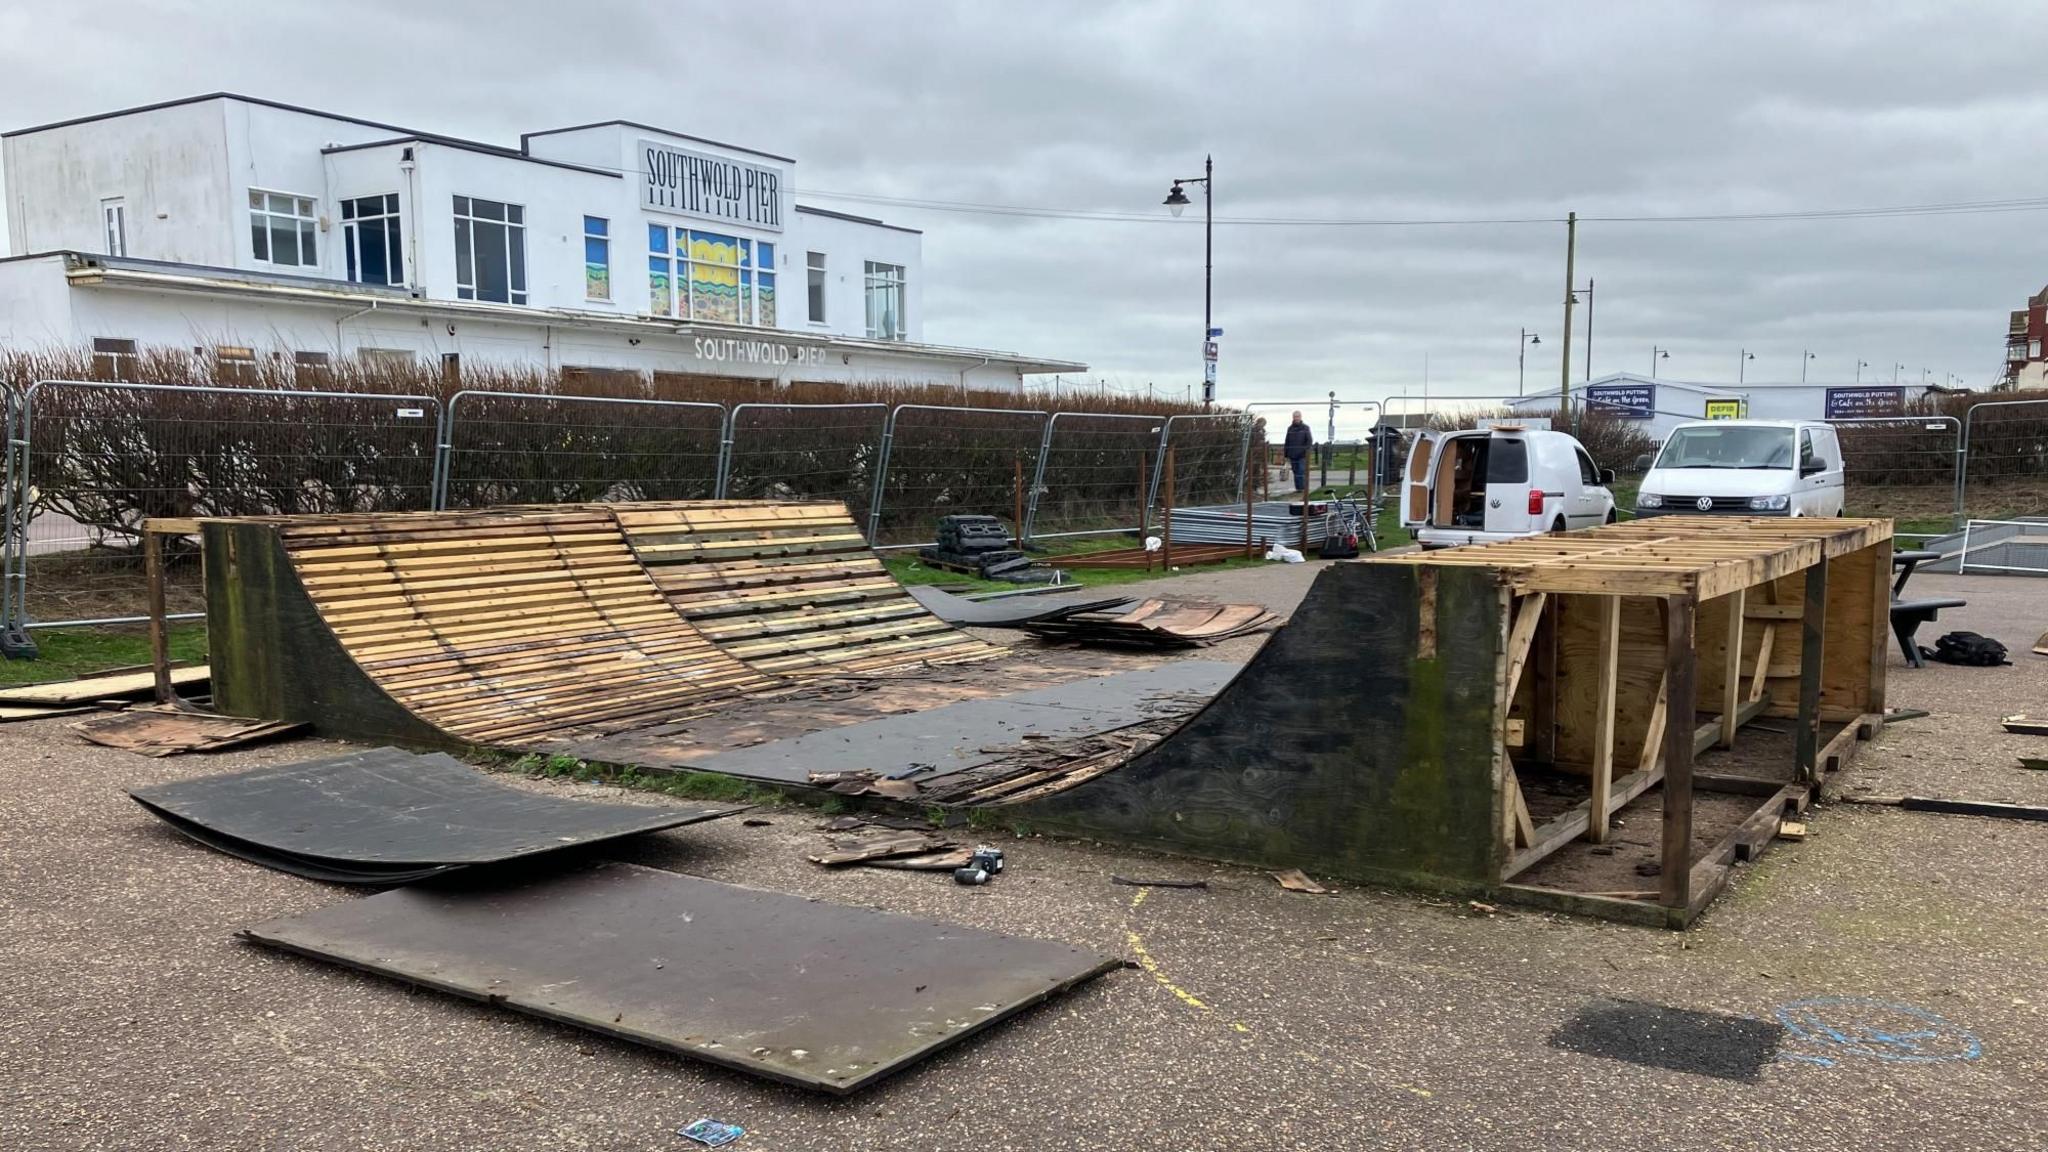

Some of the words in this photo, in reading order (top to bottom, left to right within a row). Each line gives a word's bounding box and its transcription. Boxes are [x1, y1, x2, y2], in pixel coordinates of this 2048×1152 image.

[647, 148, 742, 219] SOUTHWOLD
[745, 168, 779, 226] PIER
[694, 337, 789, 365] SOUTHWOLD
[797, 346, 826, 368] PIER
[1697, 497, 1712, 511] VW
